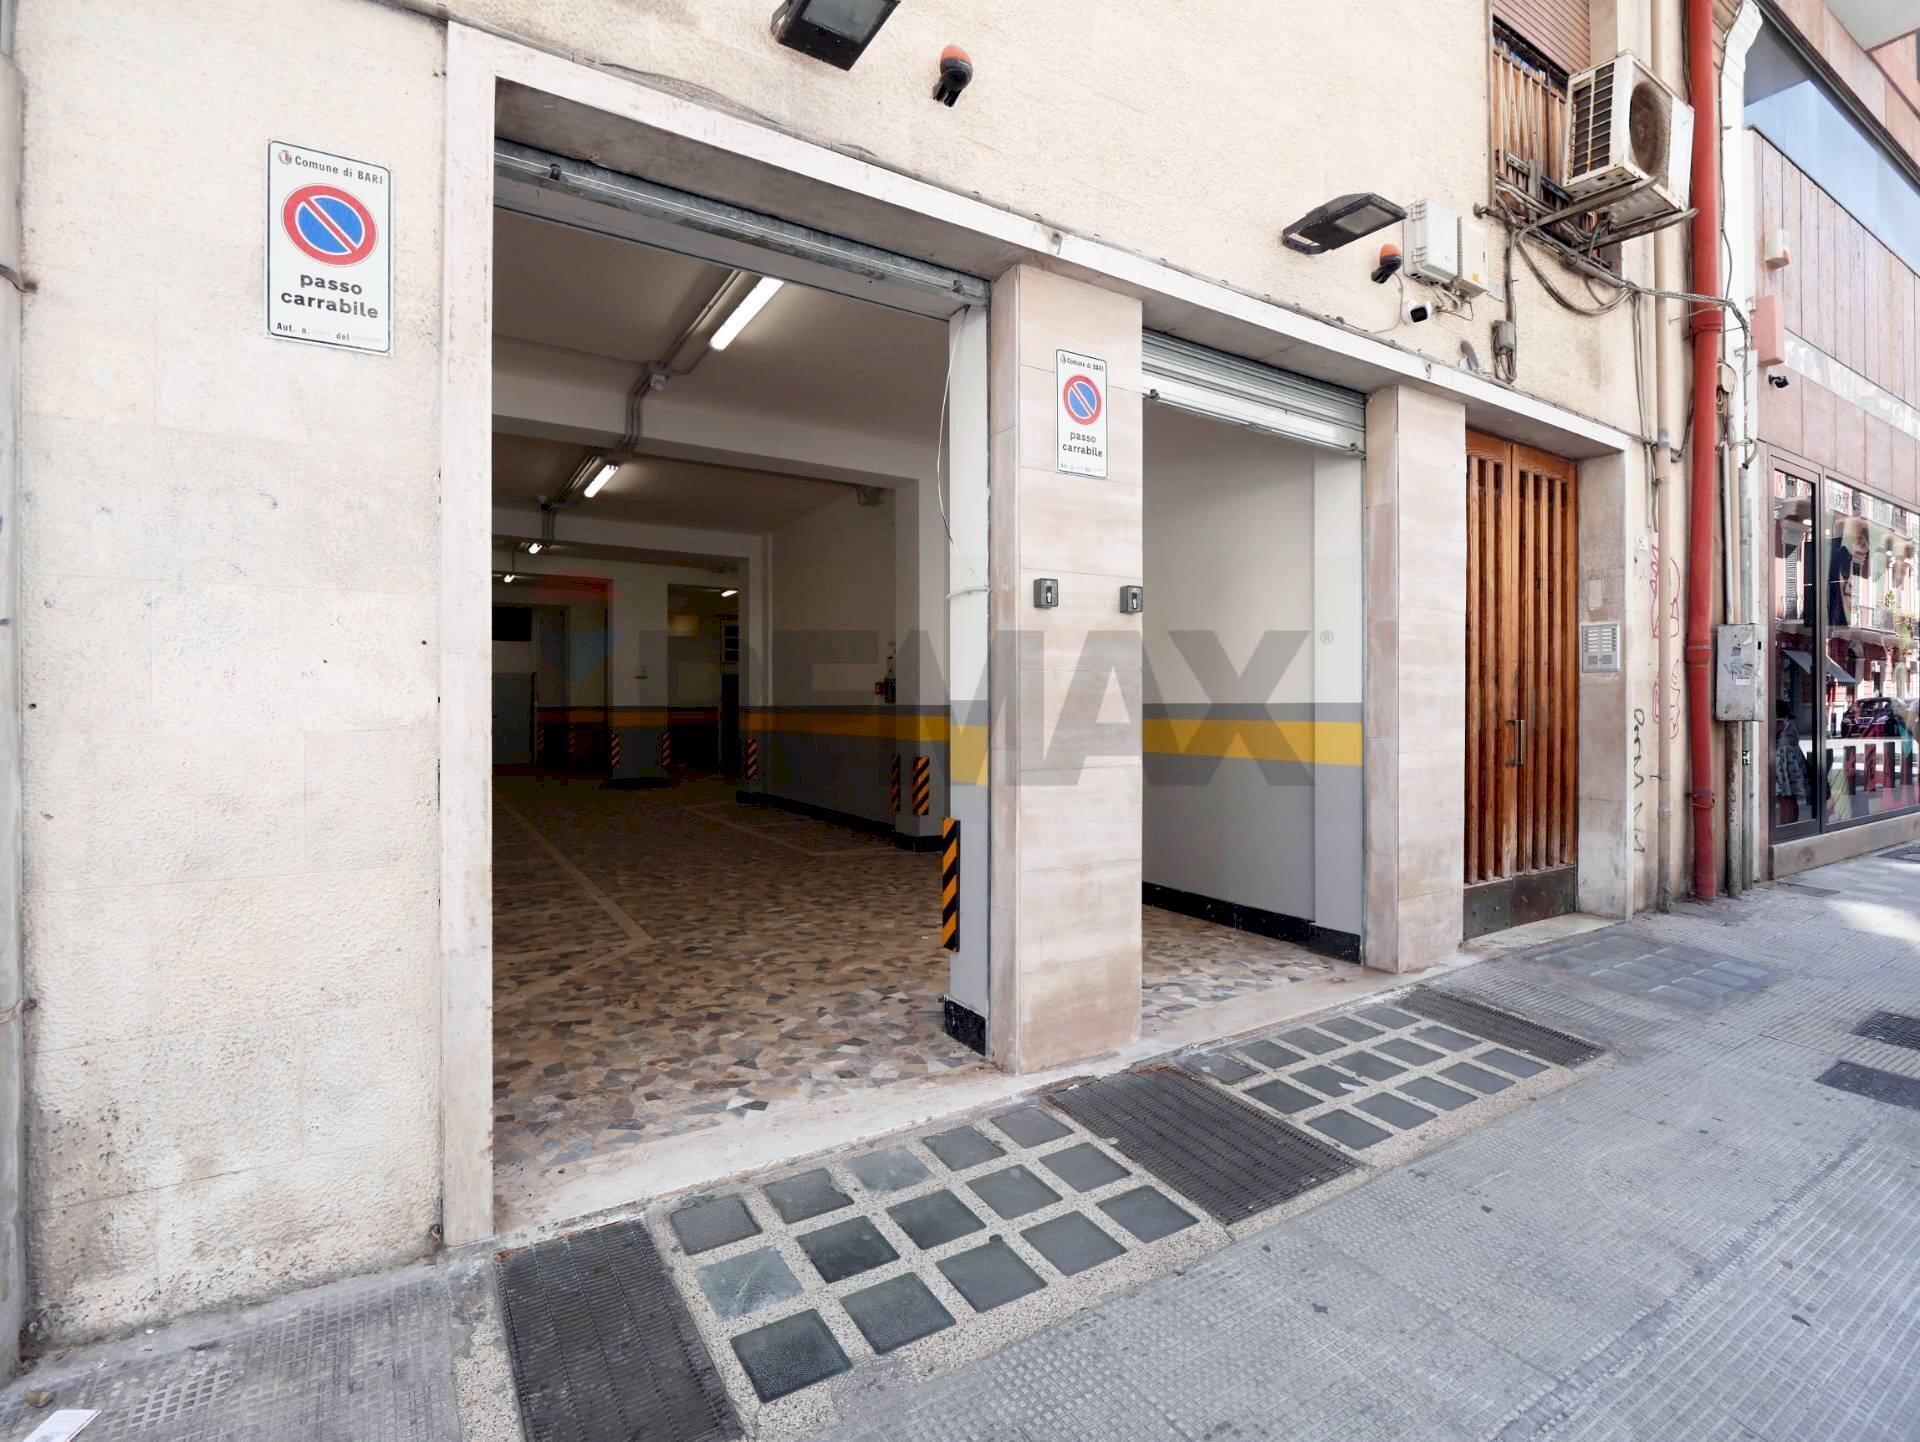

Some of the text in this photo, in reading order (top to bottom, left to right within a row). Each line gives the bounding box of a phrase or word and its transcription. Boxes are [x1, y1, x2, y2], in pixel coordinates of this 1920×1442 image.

[295, 155, 383, 184] Comune di BARI
[300, 273, 363, 295] passo
[281, 292, 379, 319] carrabile
[336, 331, 350, 341] del
[1070, 431, 1096, 444] passo
[1062, 443, 1103, 458] carrabile
